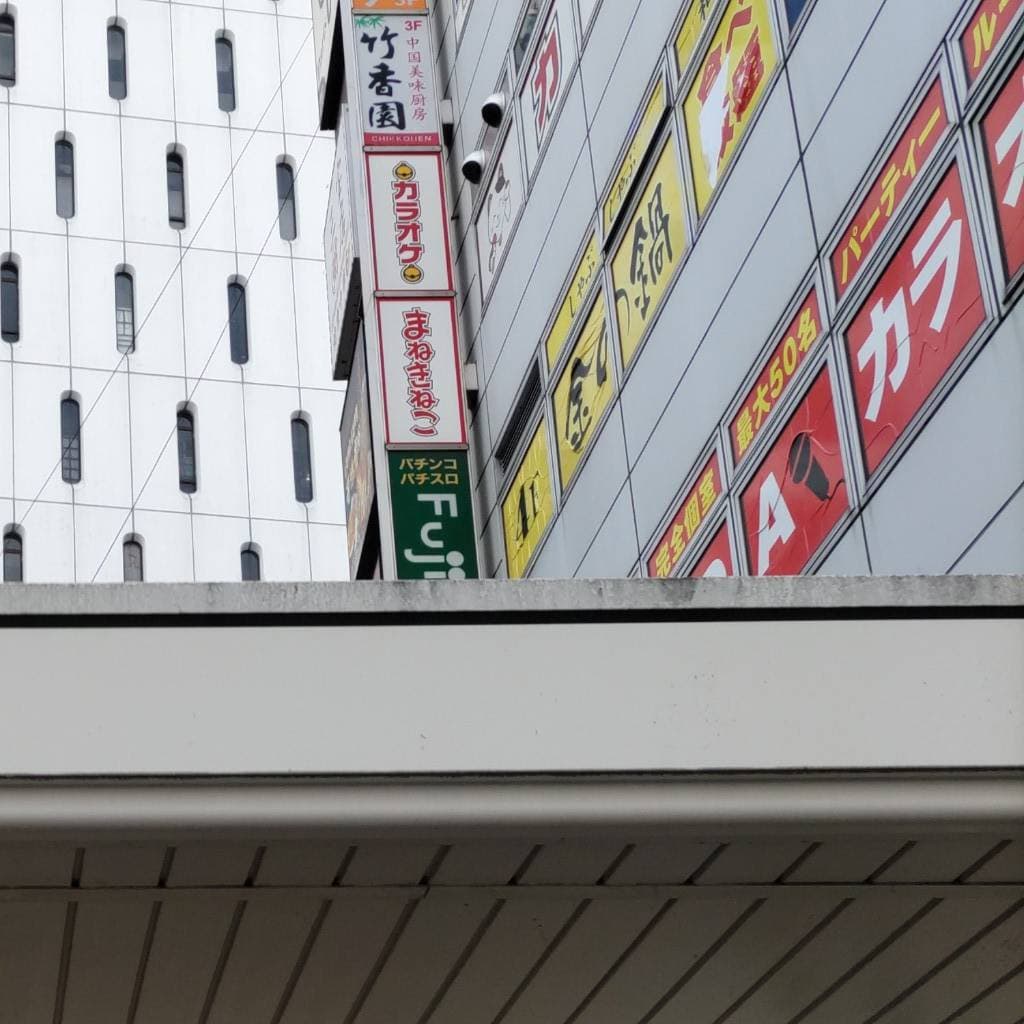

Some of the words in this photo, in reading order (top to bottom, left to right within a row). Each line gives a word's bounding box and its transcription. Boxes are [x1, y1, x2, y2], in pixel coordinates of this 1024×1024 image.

[404, 20, 422, 31] 3F
[360, 26, 406, 130] 竹香園
[392, 180, 424, 265] カラオケ
[402, 307, 439, 436] まねきねこ
[736, 307, 818, 457] 最大50名
[399, 459, 458, 470] パチンコ
[400, 473, 459, 485] パチスロ
[404, 493, 465, 580] Fuji
